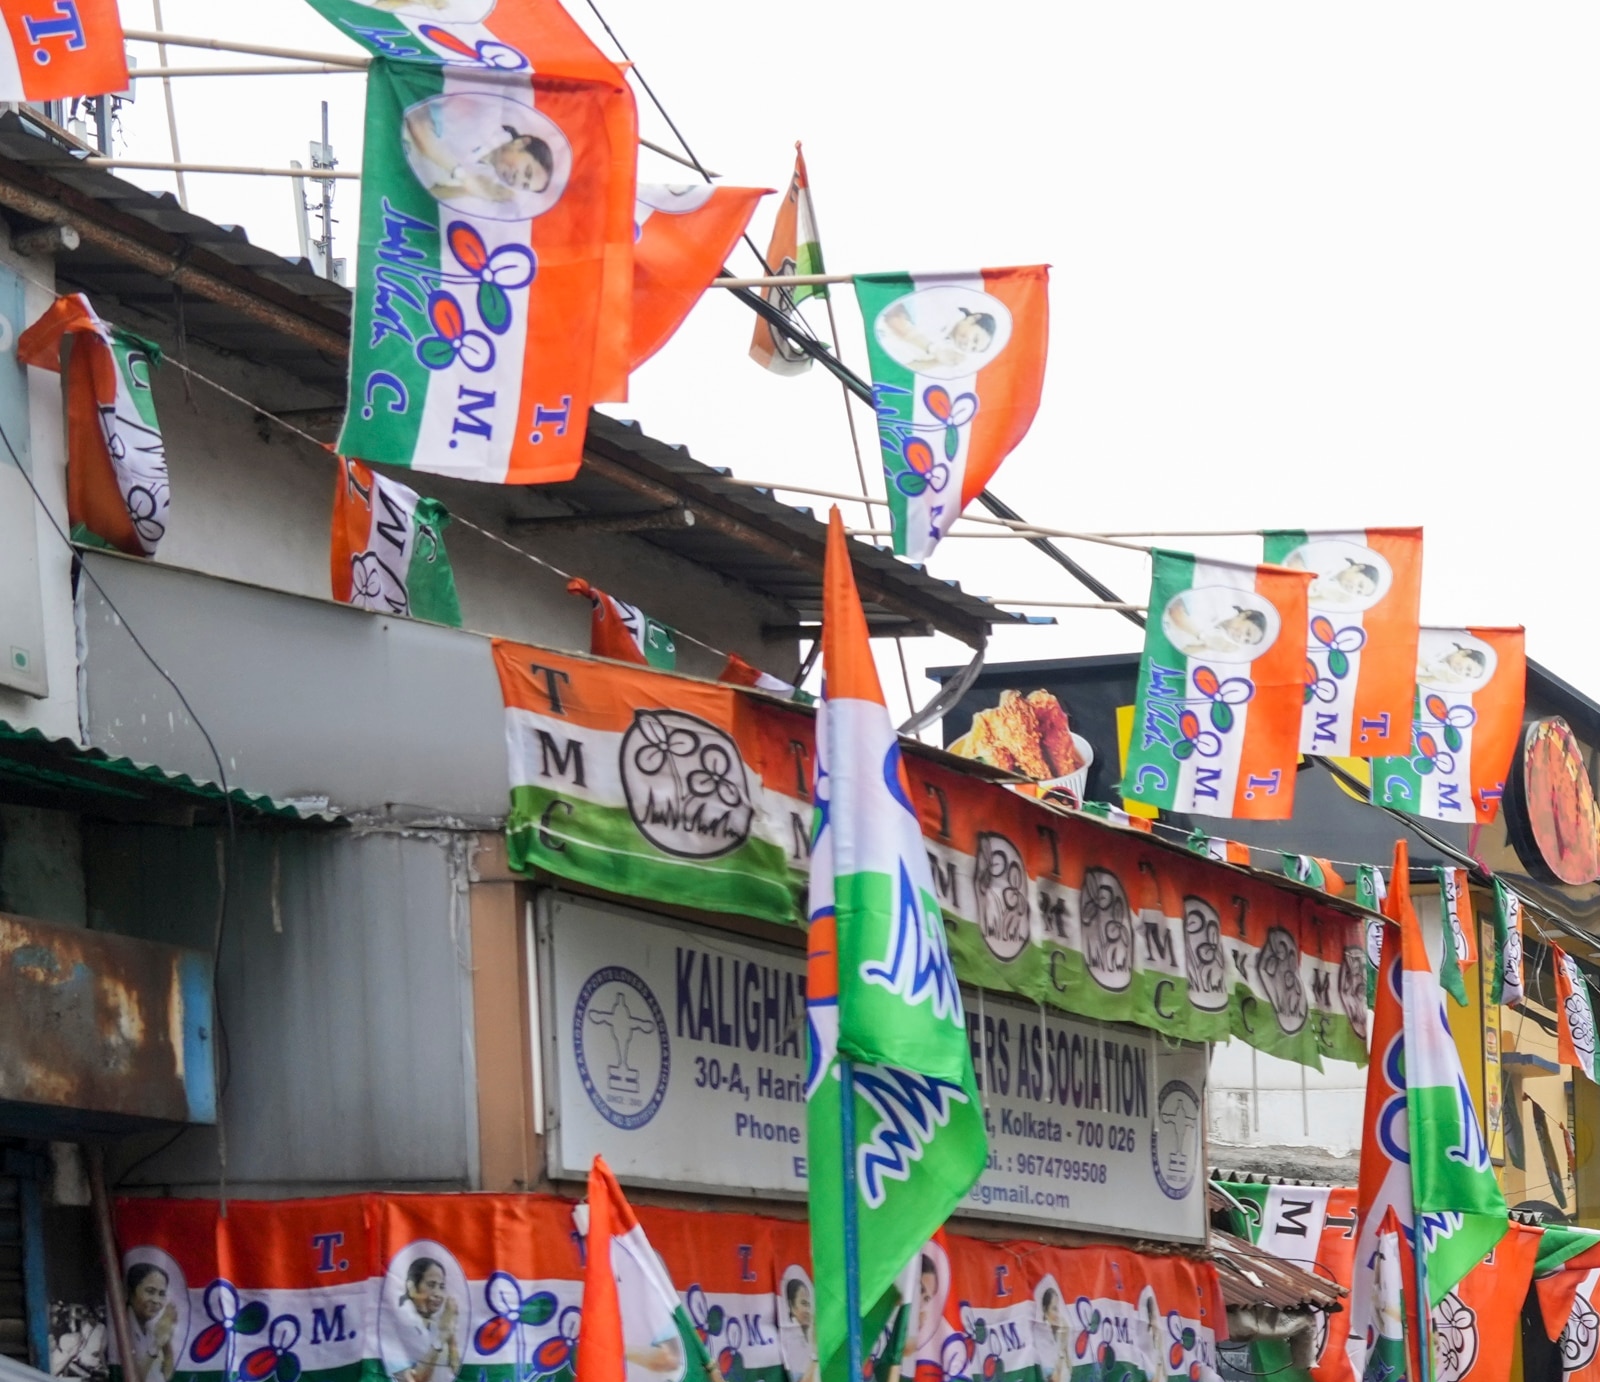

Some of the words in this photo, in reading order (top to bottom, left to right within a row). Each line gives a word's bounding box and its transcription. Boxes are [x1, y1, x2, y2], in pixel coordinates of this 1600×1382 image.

[676, 947, 808, 1058] KALIGHA
[735, 1111, 801, 1145] Phone
[1017, 1152, 1107, 1184] 9674799508
[1001, 1108, 1063, 1143] Kolkata
[1076, 1120, 1105, 1150] 700
[1108, 1126, 1136, 1153] 026
[1275, 1198, 1313, 1238] M
